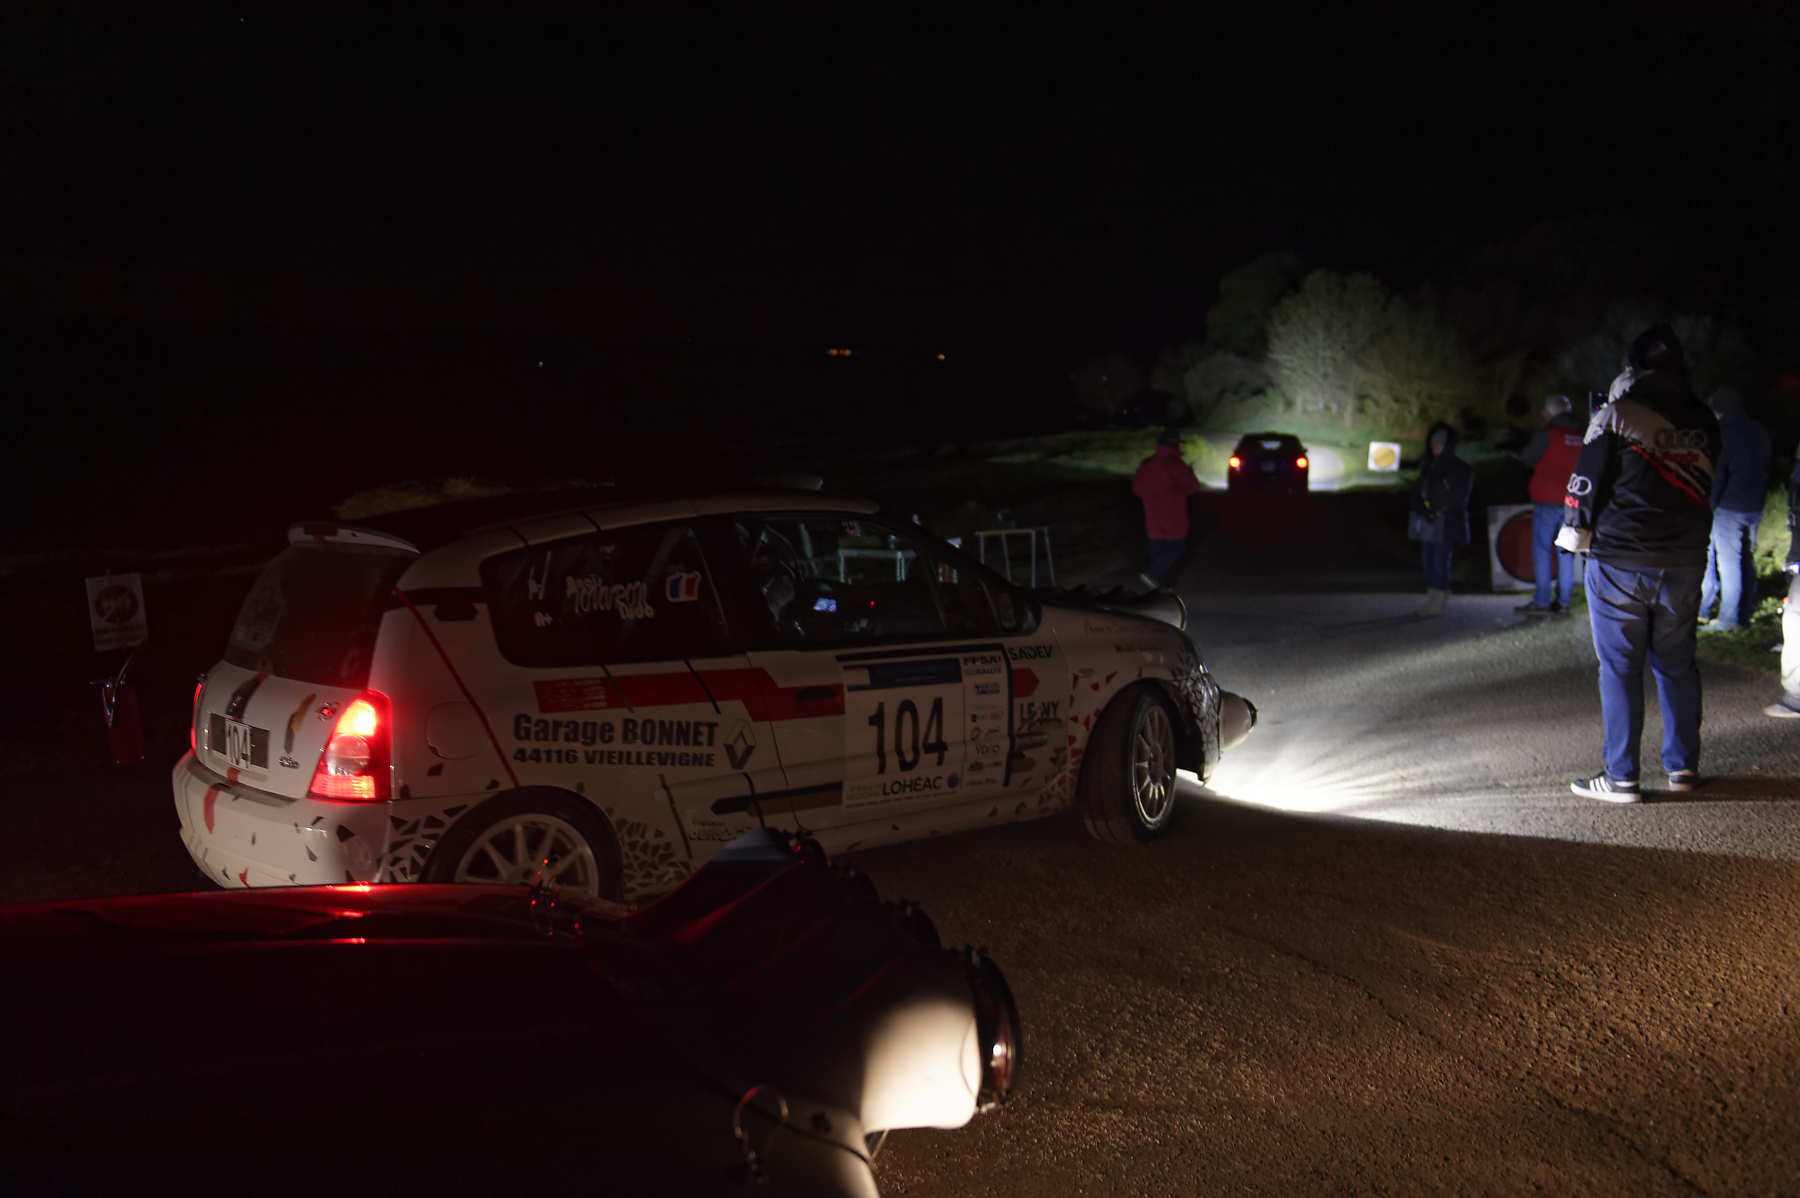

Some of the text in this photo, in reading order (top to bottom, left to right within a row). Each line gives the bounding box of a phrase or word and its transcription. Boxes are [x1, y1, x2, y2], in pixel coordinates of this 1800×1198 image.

[1009, 645, 1052, 661] SADEV
[513, 713, 718, 746] Garage BONNET
[868, 697, 948, 775] 104
[513, 748, 715, 768] 44116 VIEILLEVIGNE
